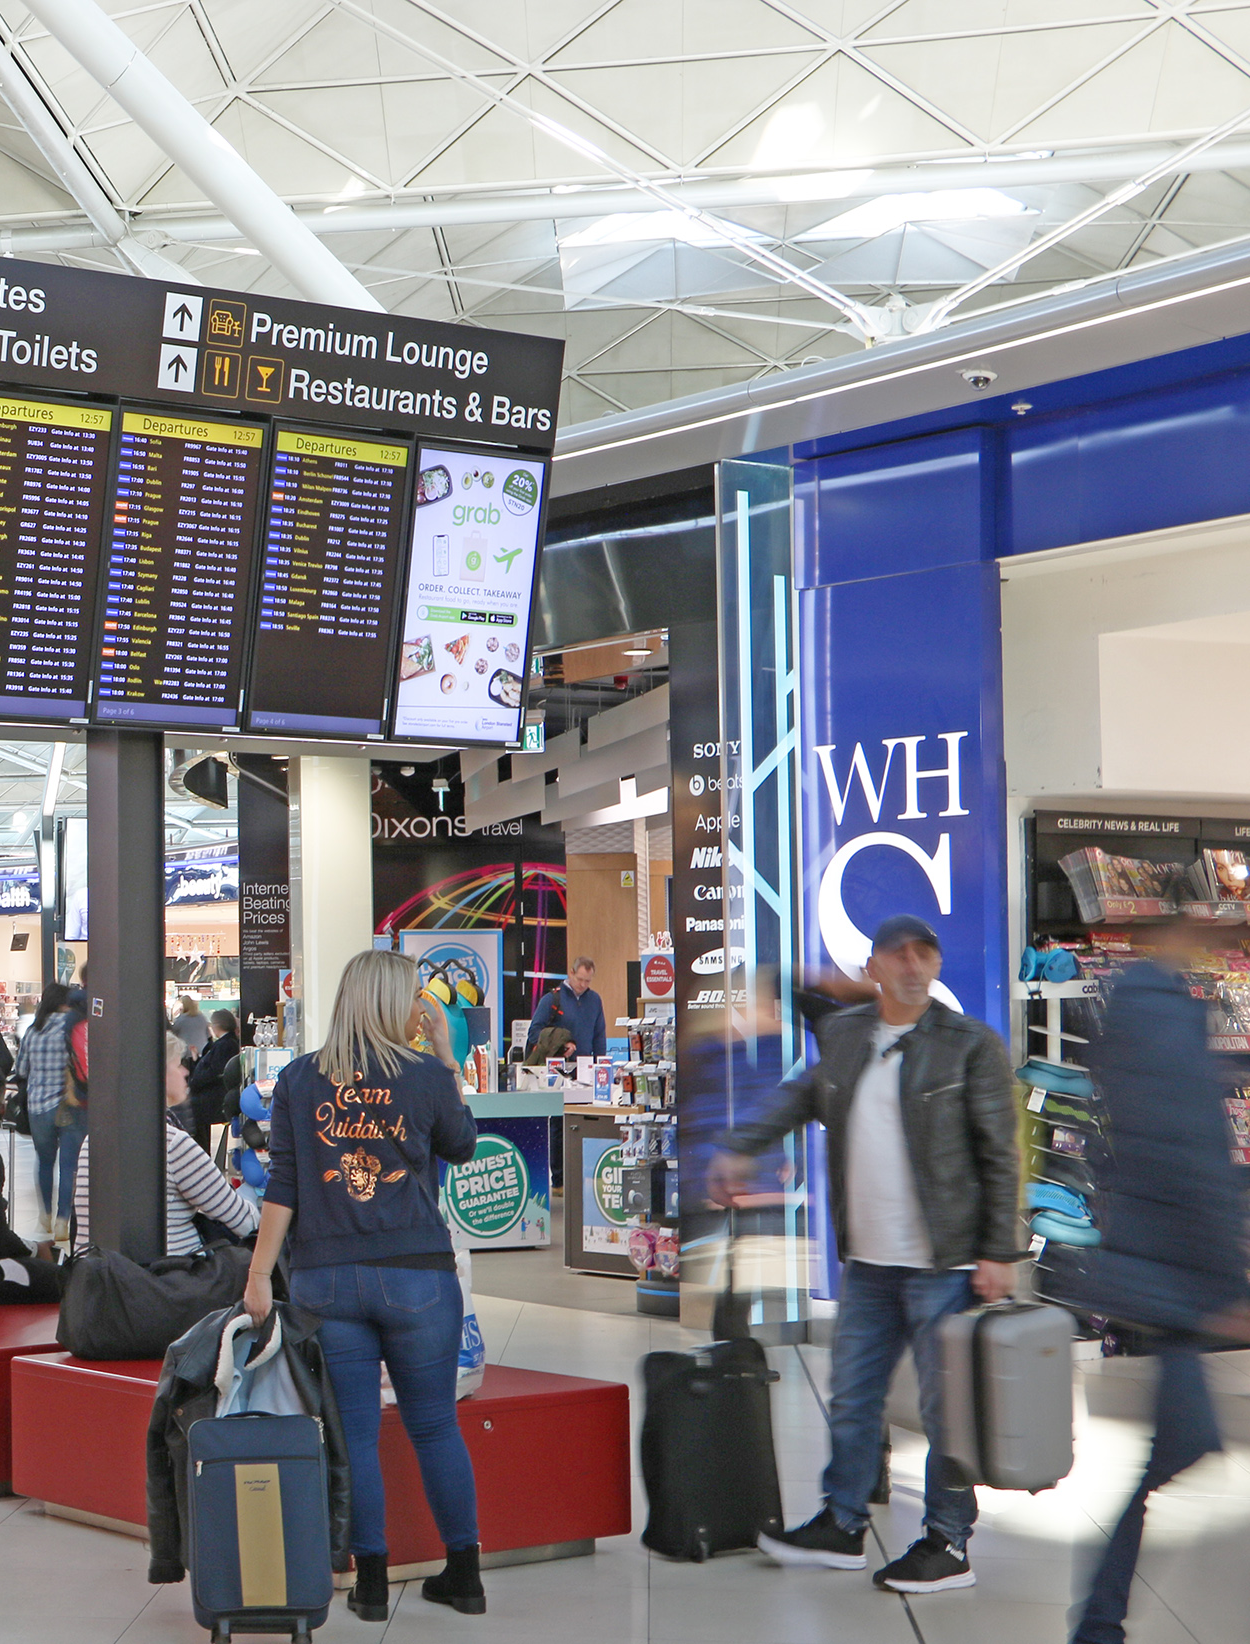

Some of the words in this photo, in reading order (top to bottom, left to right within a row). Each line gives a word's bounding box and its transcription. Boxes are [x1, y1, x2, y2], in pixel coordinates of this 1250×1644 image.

[250, 312, 377, 359] Premium
[385, 332, 488, 379] Lounge
[288, 368, 457, 419] Restaurants
[464, 392, 482, 423] &
[491, 395, 551, 431] Bars
[80, 414, 104, 424] 12:57
[144, 418, 208, 437] Departures
[234, 431, 255, 441] 12:57
[296, 438, 357, 456] Departures
[380, 450, 400, 460] 12:57
[452, 502, 501, 526] grab
[418, 582, 446, 593] ORDER.
[448, 586, 481, 596] COLLECT.
[484, 588, 522, 600] TAKEAWAY
[813, 731, 970, 826] WH
[1058, 818, 1103, 830] CELEBRITY
[1104, 821, 1128, 831] NEWS
[1131, 823, 1136, 831] &
[1138, 823, 1160, 832] REAL
[1163, 823, 1180, 832] LIFE
[180, 870, 222, 899] beauty
[243, 882, 289, 895] Interne
[243, 912, 285, 924] Prices
[453, 1151, 513, 1178] LOWEST
[456, 1167, 517, 1199] PRICE
[459, 1187, 519, 1210] GUARANTEE
[478, 1206, 492, 1215] we'll
[493, 1201, 514, 1211] double
[484, 1210, 514, 1222] difference
